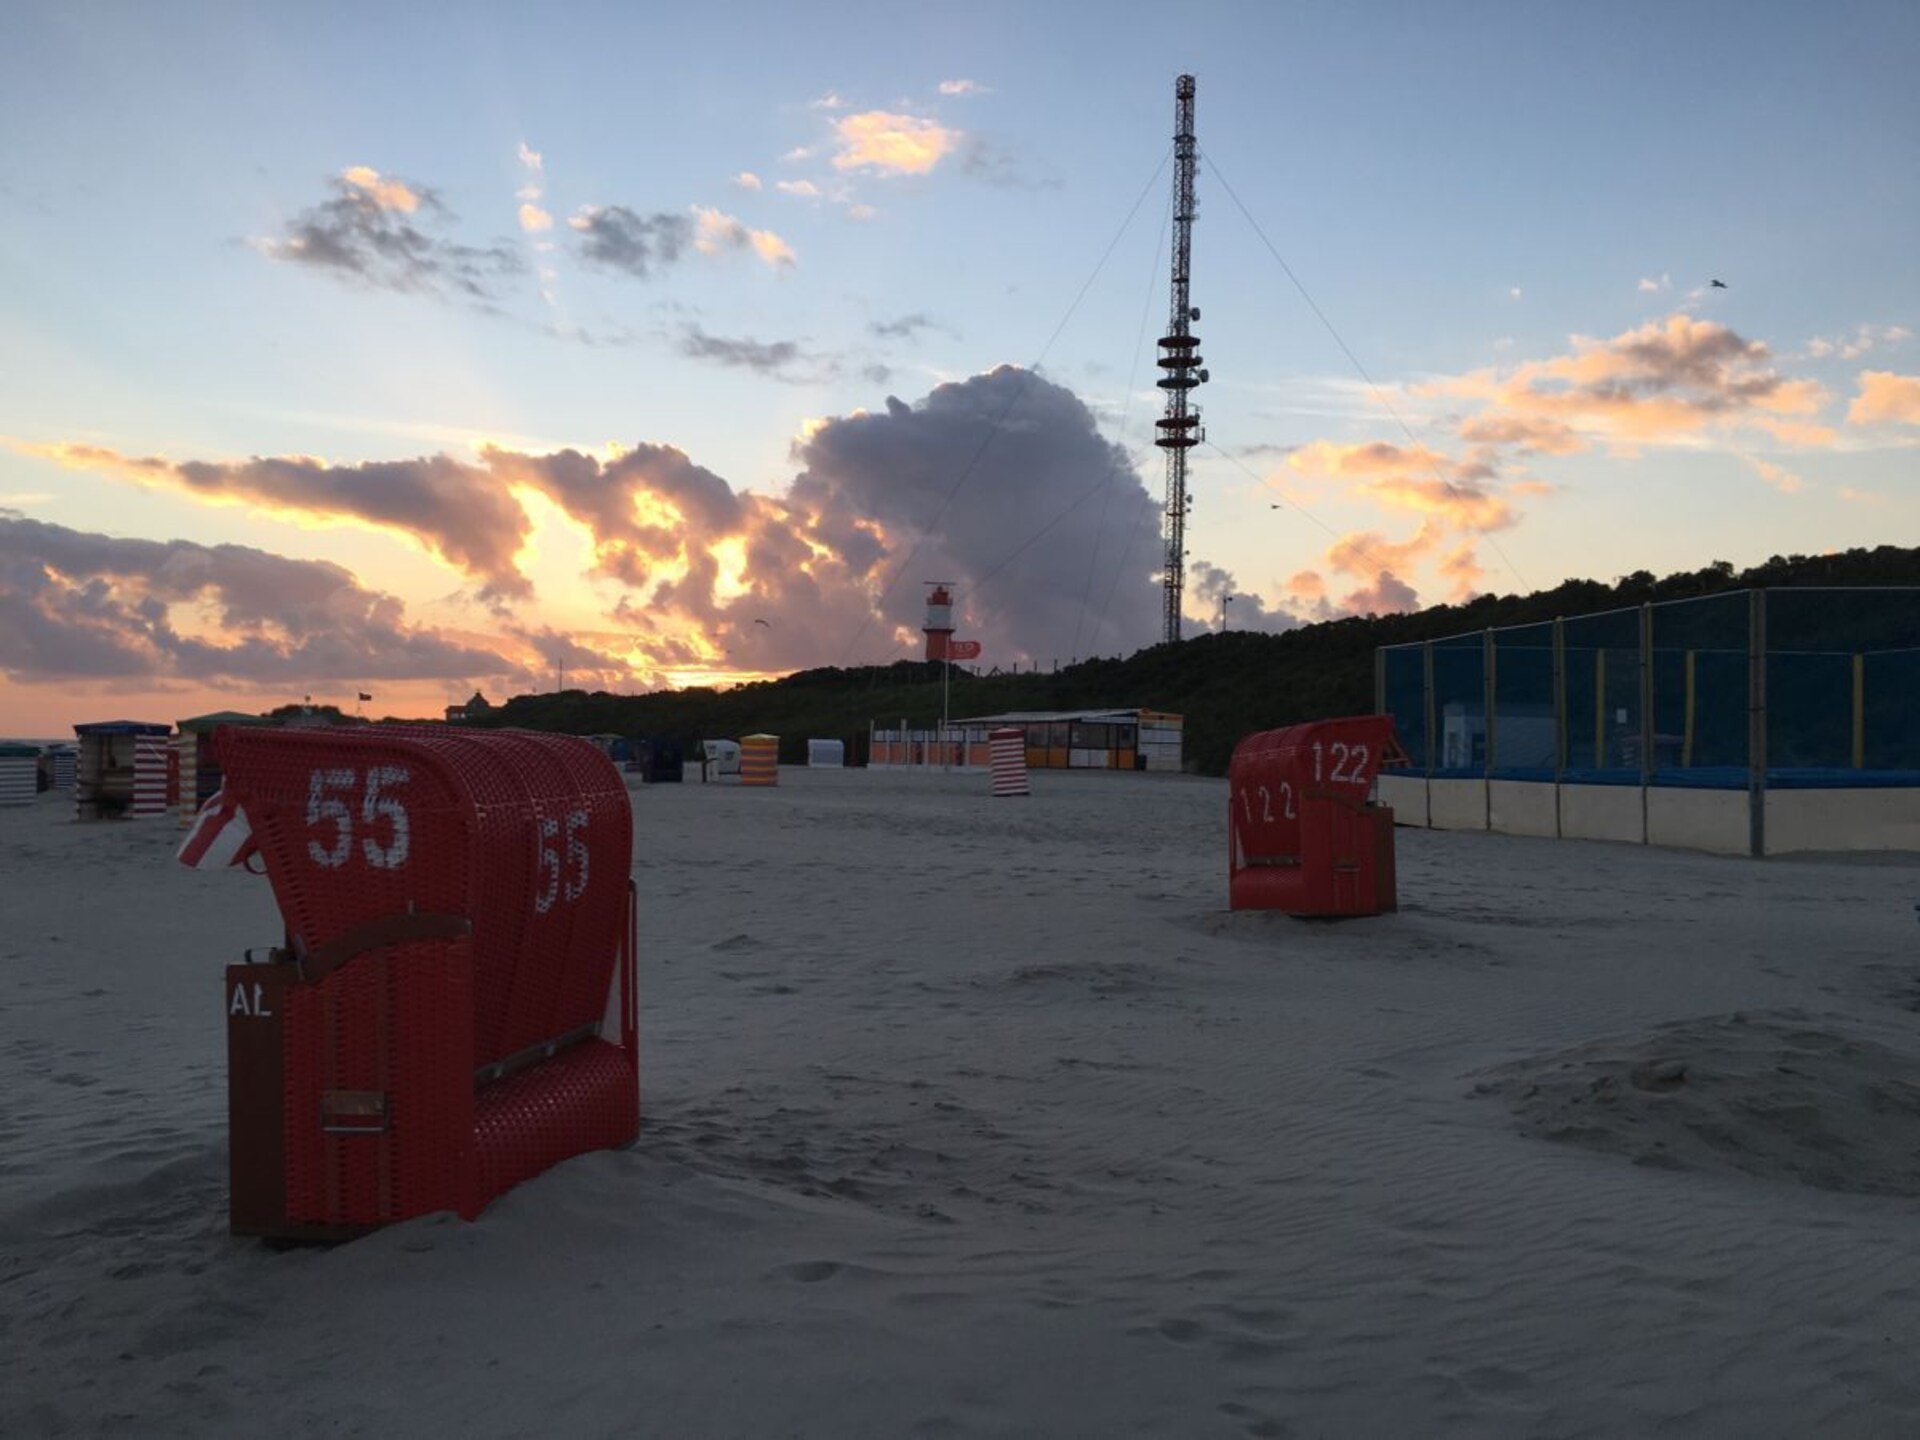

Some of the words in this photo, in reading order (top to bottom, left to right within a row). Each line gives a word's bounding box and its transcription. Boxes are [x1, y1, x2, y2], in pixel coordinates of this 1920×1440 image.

[1312, 741, 1370, 784] 122
[304, 764, 411, 870] 55
[1240, 781, 1297, 824] 122
[535, 809, 590, 914] 55
